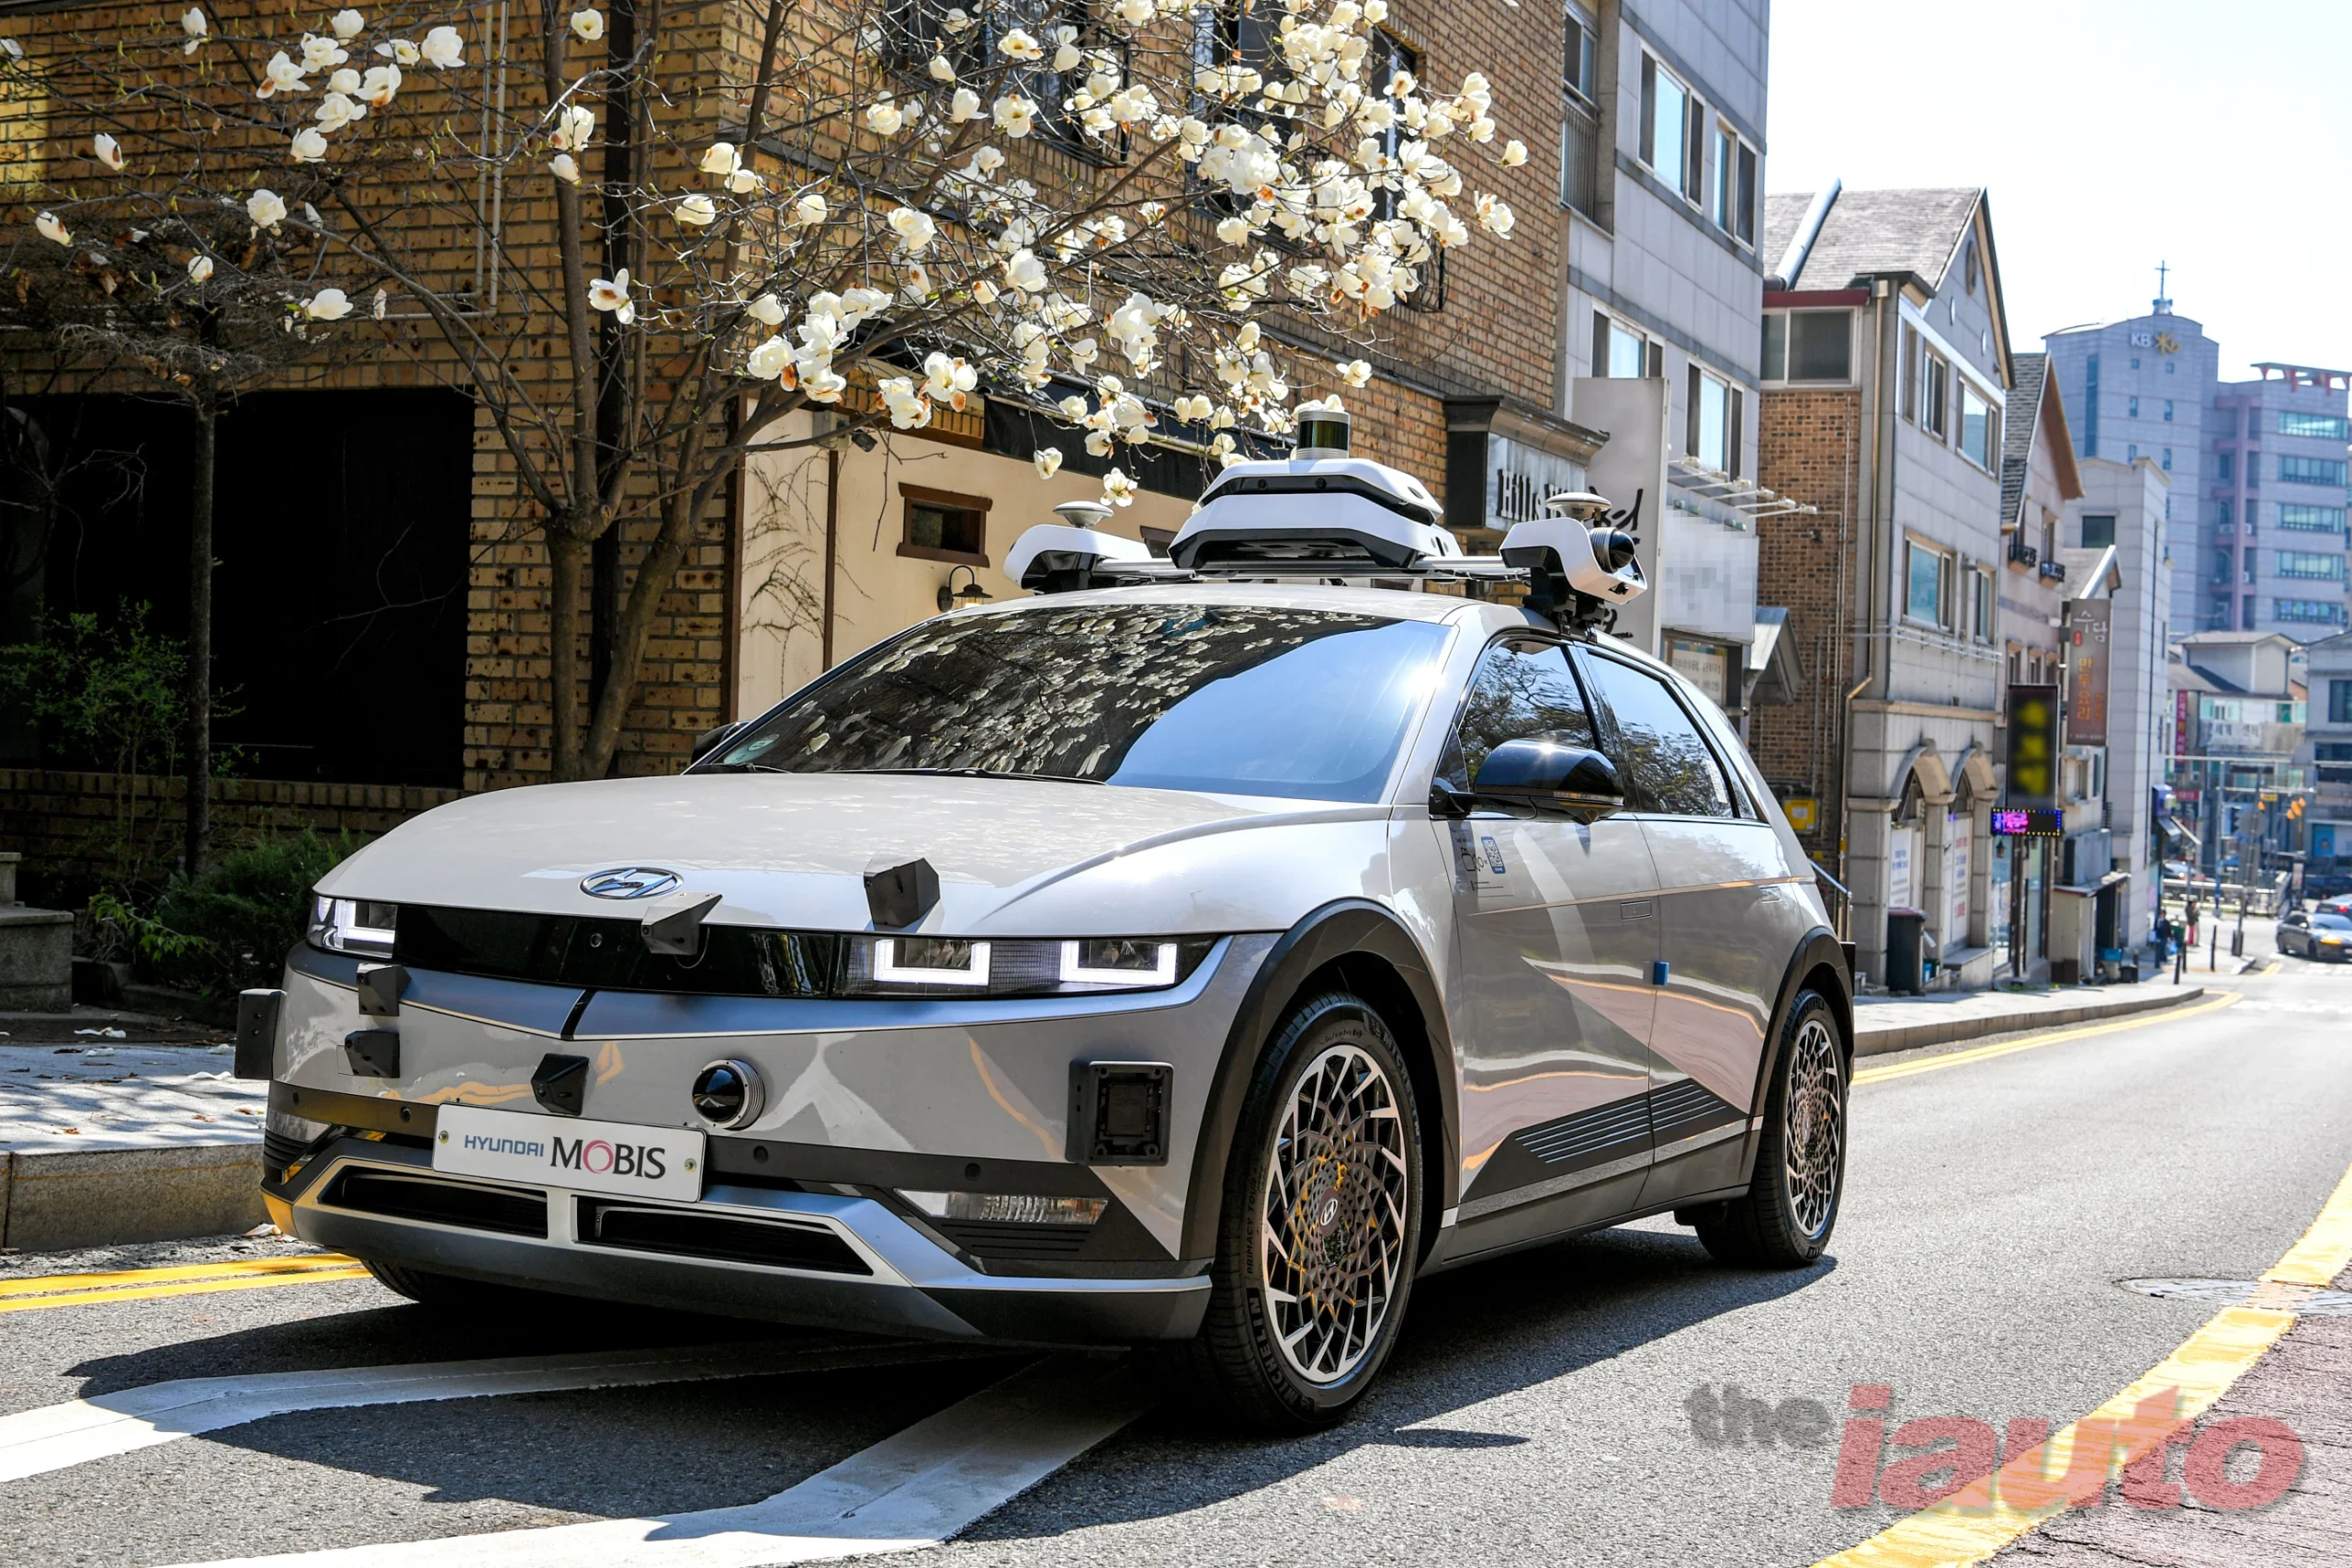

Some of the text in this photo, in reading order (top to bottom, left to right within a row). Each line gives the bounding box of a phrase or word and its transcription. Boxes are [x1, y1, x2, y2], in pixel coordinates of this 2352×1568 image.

[2132, 332, 2151, 348] KB
[1497, 468, 1544, 522] Hills
[2073, 610, 2109, 642] 수담
[2077, 657, 2094, 721] 만두요리
[464, 1134, 666, 1179] HYUNDAI MOBIS
[1246, 1177, 1258, 1275] PRIMACY TOUR
[1249, 1296, 1299, 1405] MICHELIN
